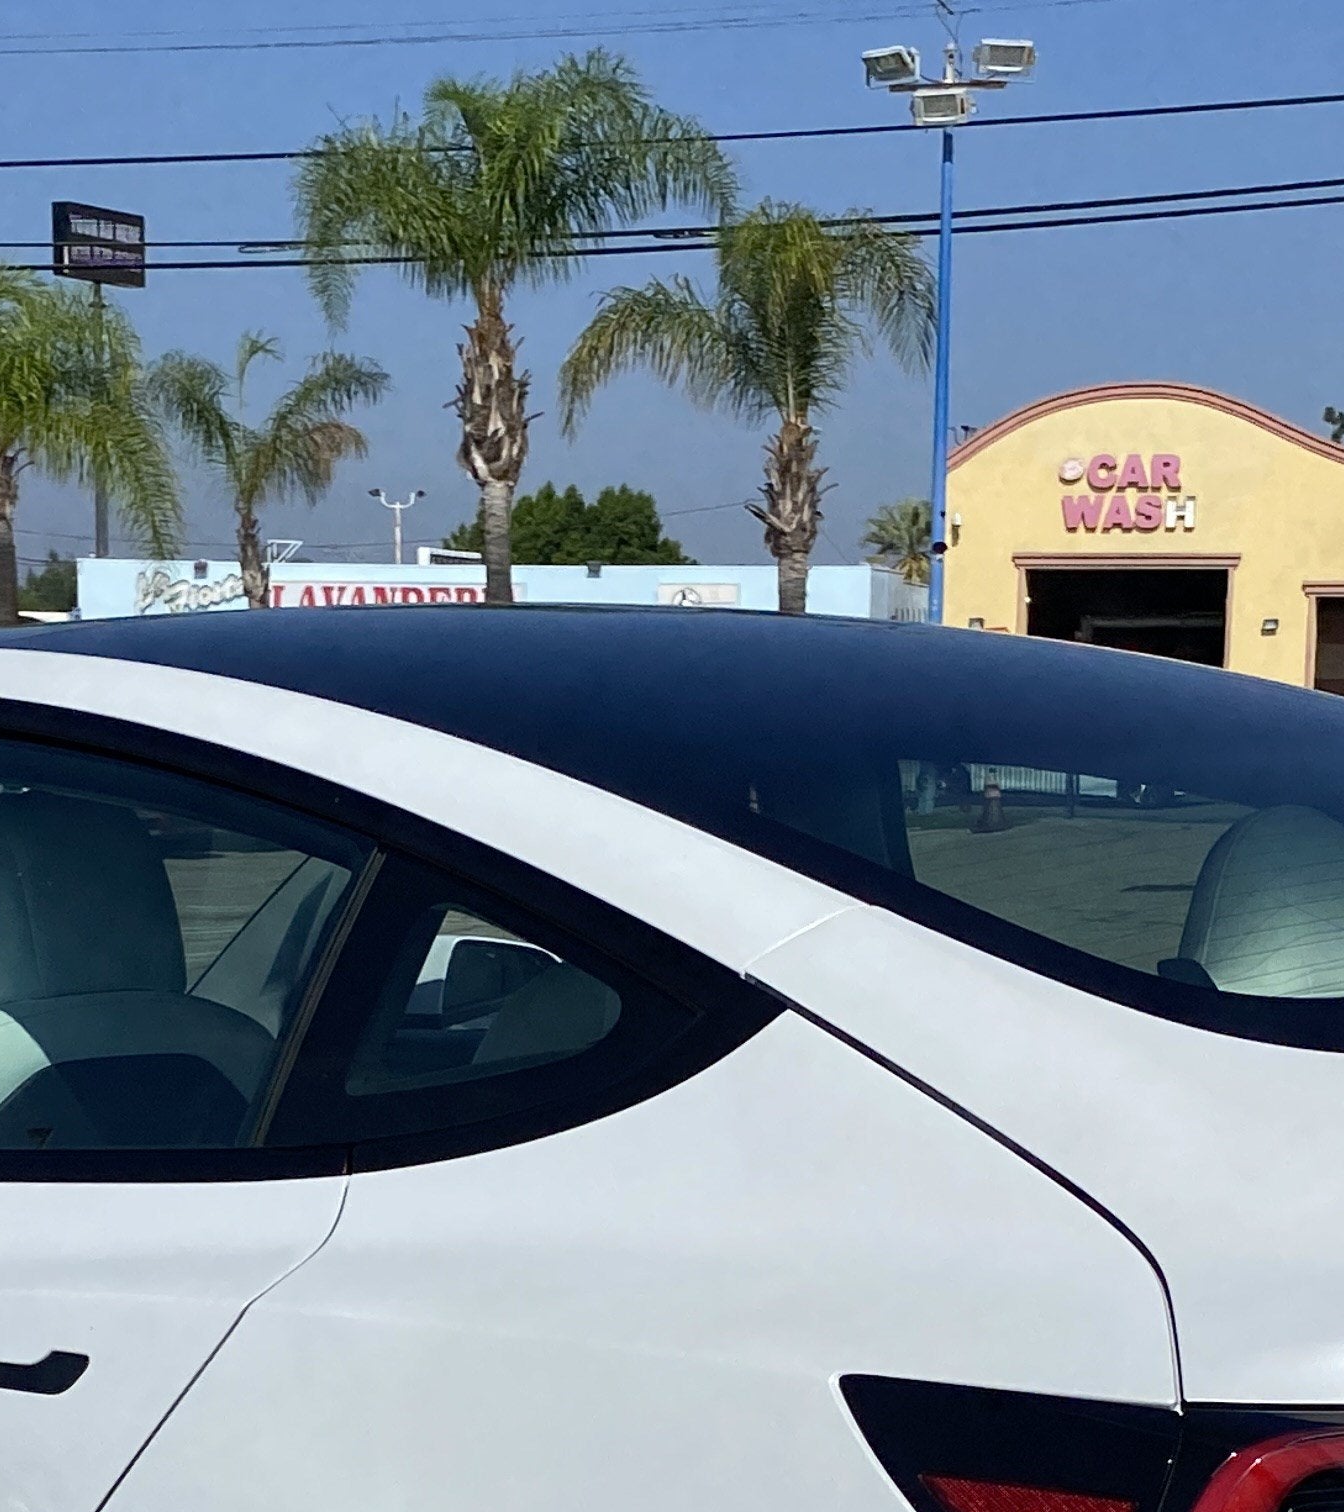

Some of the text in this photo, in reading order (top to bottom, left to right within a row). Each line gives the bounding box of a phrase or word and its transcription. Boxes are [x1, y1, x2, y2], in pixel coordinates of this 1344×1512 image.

[1087, 453, 1182, 492] CAR
[1061, 494, 1196, 533] WASH
[272, 585, 513, 608] LAVANDER
